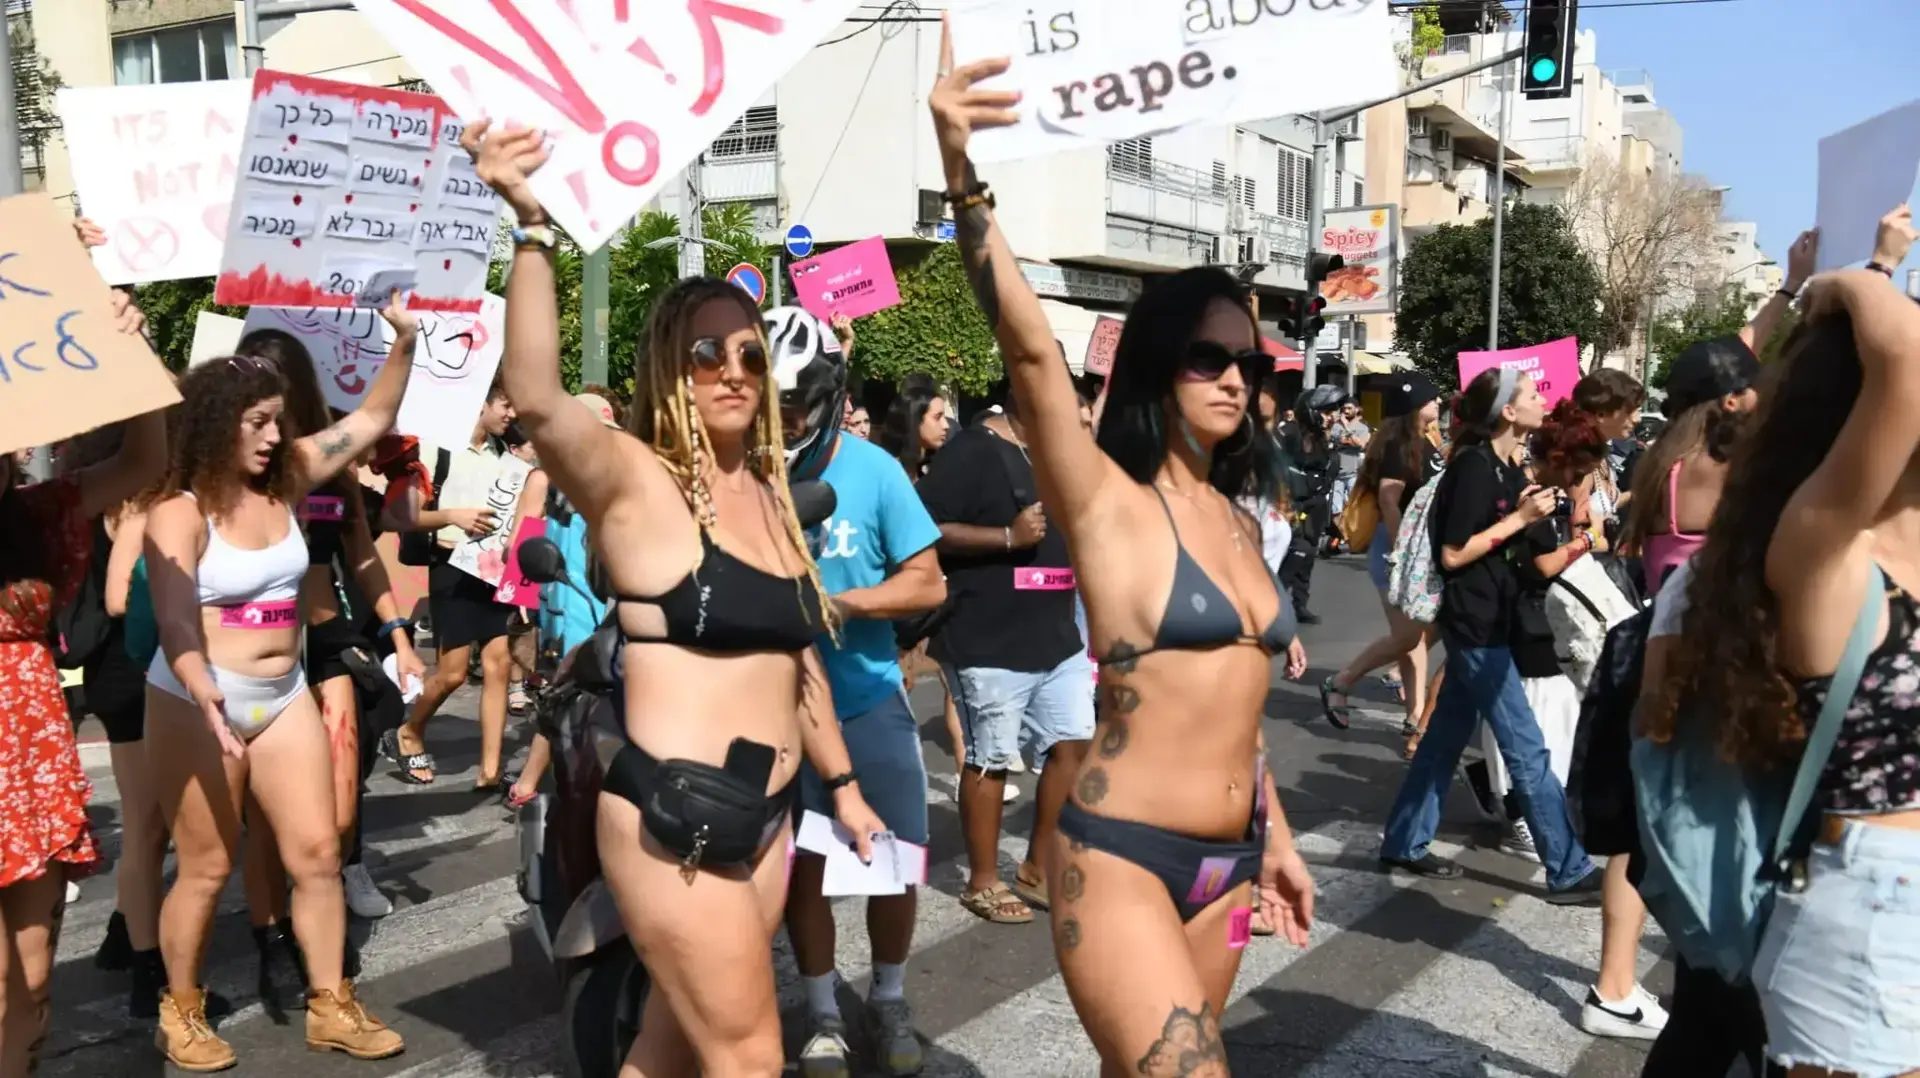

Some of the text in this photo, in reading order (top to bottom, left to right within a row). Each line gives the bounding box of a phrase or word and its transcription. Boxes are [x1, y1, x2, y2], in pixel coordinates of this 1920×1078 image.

[1024, 8, 1080, 56] is
[1052, 49, 1238, 119] rape.
[274, 103, 300, 128] כך
[308, 101, 334, 126] כל
[367, 111, 428, 136] מכירה
[250, 155, 329, 179] שנאנסו
[360, 164, 408, 185] נשים
[246, 210, 489, 243] אבל אף גבר לא מכיר
[1322, 225, 1379, 250] Spicy
[1340, 250, 1379, 263] uggets
